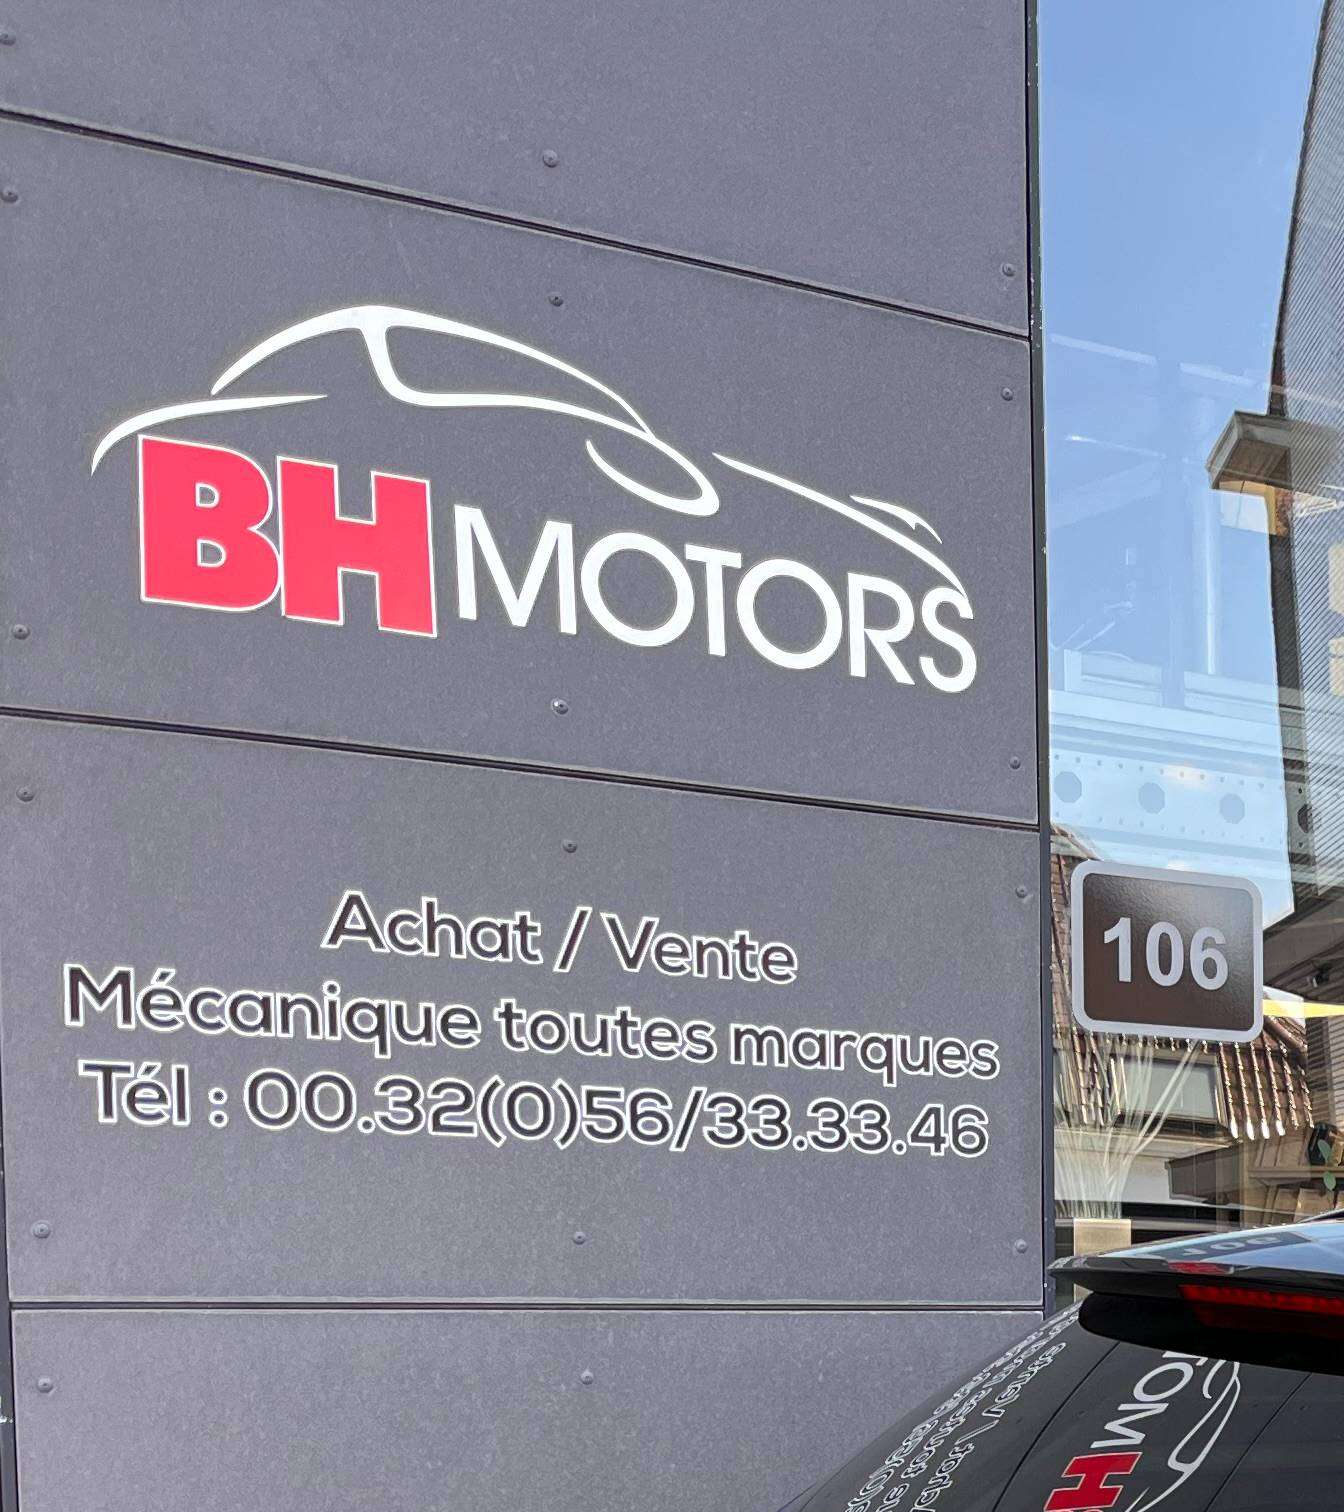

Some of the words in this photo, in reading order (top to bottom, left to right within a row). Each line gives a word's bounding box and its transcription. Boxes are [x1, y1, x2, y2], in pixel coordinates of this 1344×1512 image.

[137, 434, 437, 639] BH
[453, 503, 978, 694] MOTORS
[319, 888, 543, 967] Achat
[551, 905, 595, 974] /
[600, 911, 799, 985] Vente
[1103, 917, 1229, 990] 106
[61, 963, 481, 1058] Mécanique
[492, 997, 718, 1063] toutes
[728, 1022, 1001, 1088] marques
[242, 1068, 990, 1158] 00.32(0)56/33.33.46
